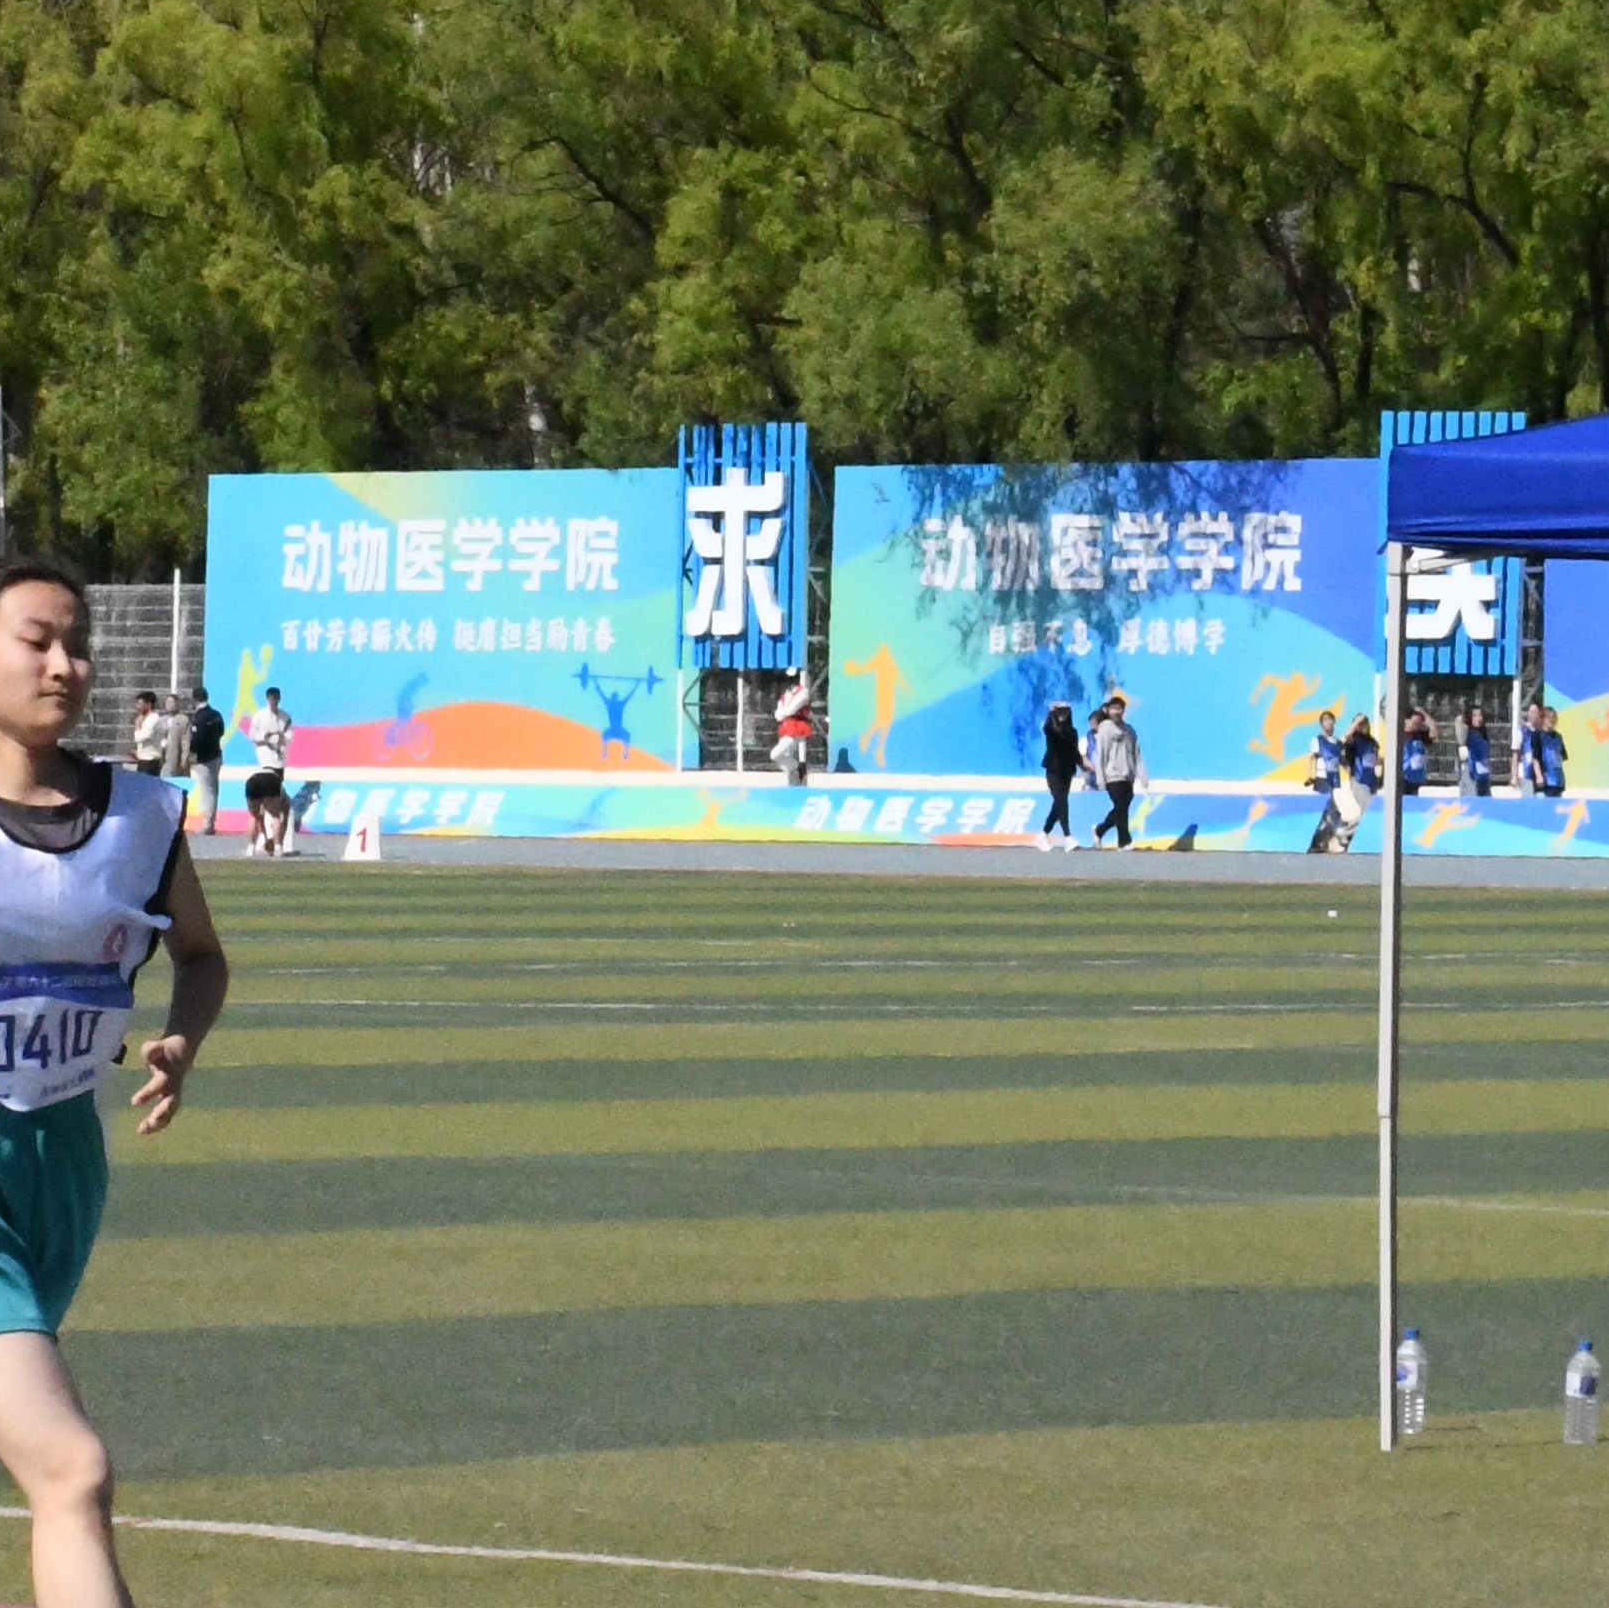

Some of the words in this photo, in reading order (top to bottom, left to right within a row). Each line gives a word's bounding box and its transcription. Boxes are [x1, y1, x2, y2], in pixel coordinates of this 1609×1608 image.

[281, 516, 619, 593] 动物医学学院
[686, 467, 786, 636] 求
[919, 511, 1303, 592] 动物医学学院
[988, 618, 1093, 656] 自强不息
[356, 827, 368, 852] 1
[793, 794, 1037, 835] 动物医学学院
